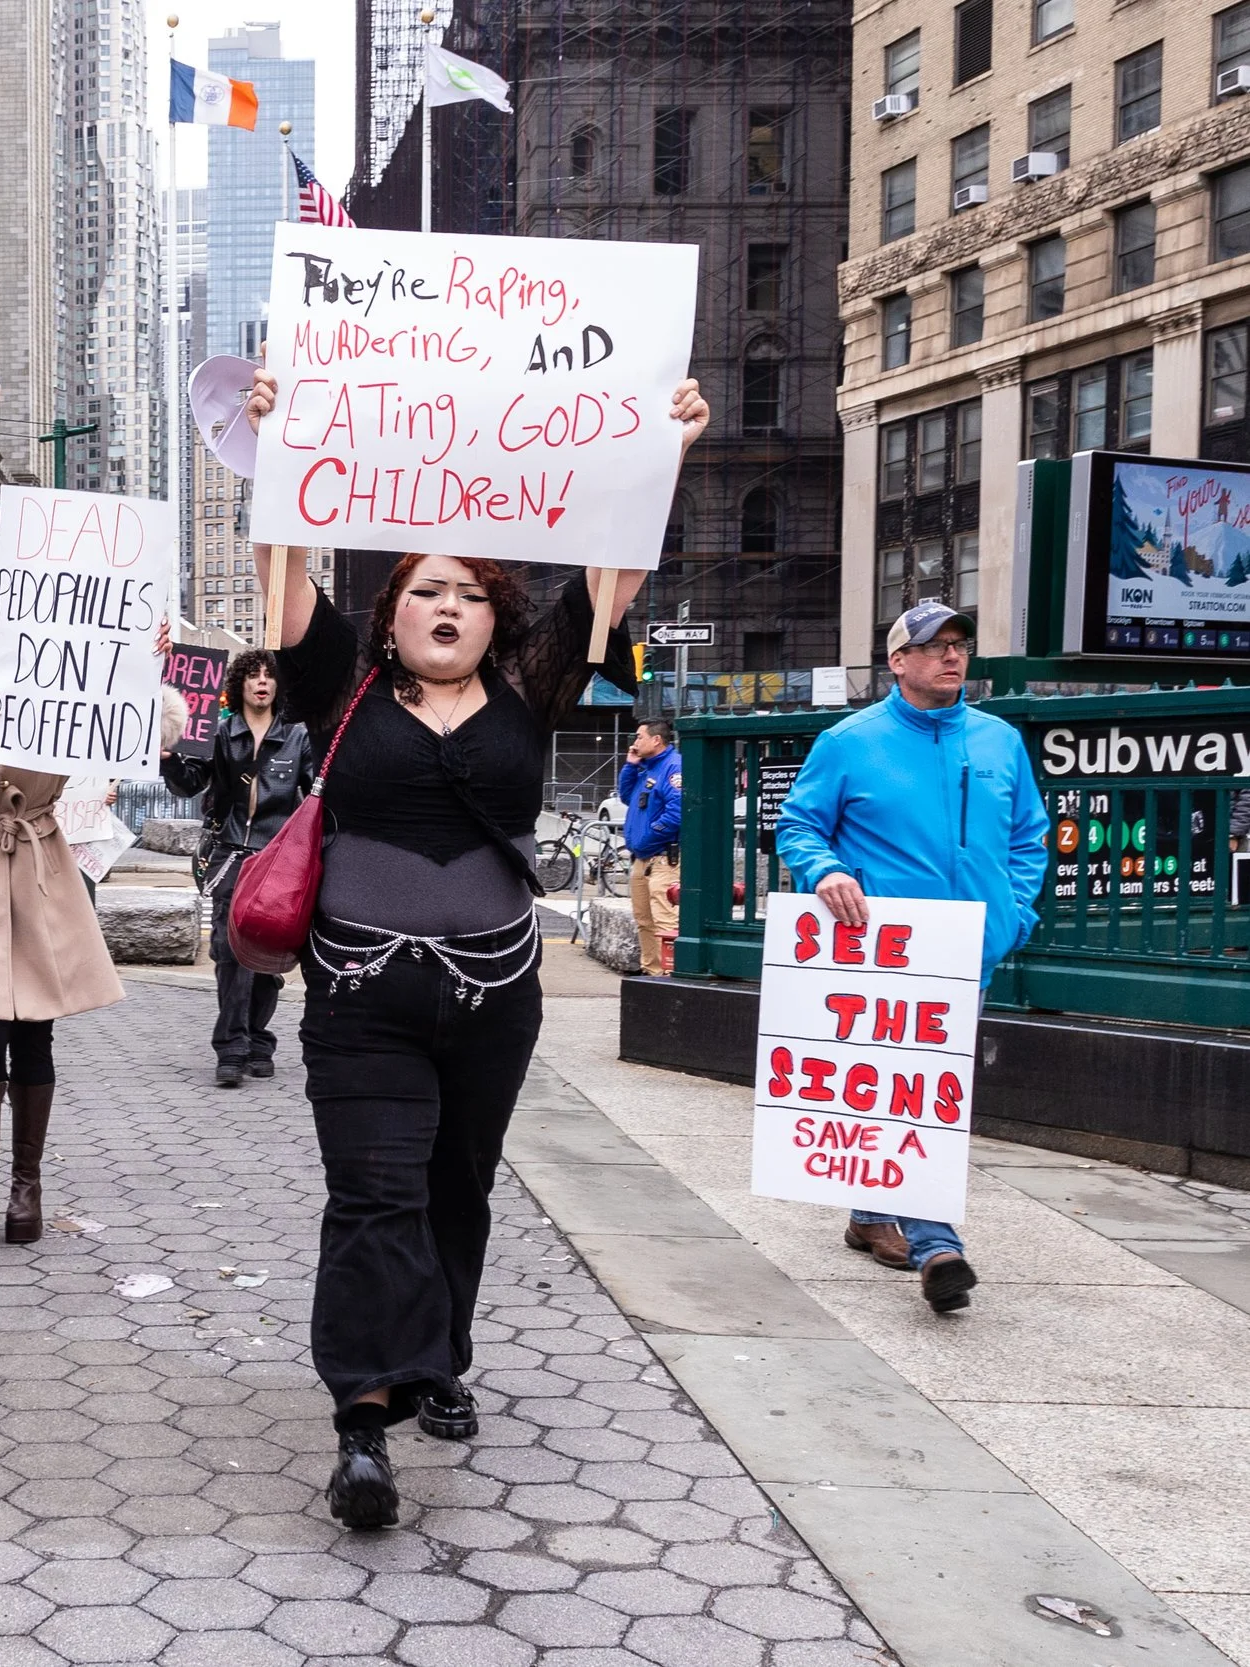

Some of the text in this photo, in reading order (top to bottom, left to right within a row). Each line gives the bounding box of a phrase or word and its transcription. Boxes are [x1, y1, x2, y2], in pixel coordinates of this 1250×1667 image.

[16, 497, 144, 567] DEAD
[1121, 588, 1153, 603] IKON
[1189, 601, 1246, 612] STRATTON.COM
[658, 631, 676, 639] ONE
[14, 633, 130, 695] DON'T
[1043, 727, 1250, 777] Subway
[762, 771, 787, 780] Bicycles
[1061, 827, 1072, 845] Z
[1167, 859, 1174, 870] 5
[1193, 858, 1206, 872] at
[1092, 880, 1102, 894] &
[795, 911, 912, 968] SEE
[825, 992, 950, 1045] THE
[768, 1046, 963, 1124] SIGNS
[793, 1117, 927, 1159] SAVE A
[804, 1152, 904, 1188] CHILD
